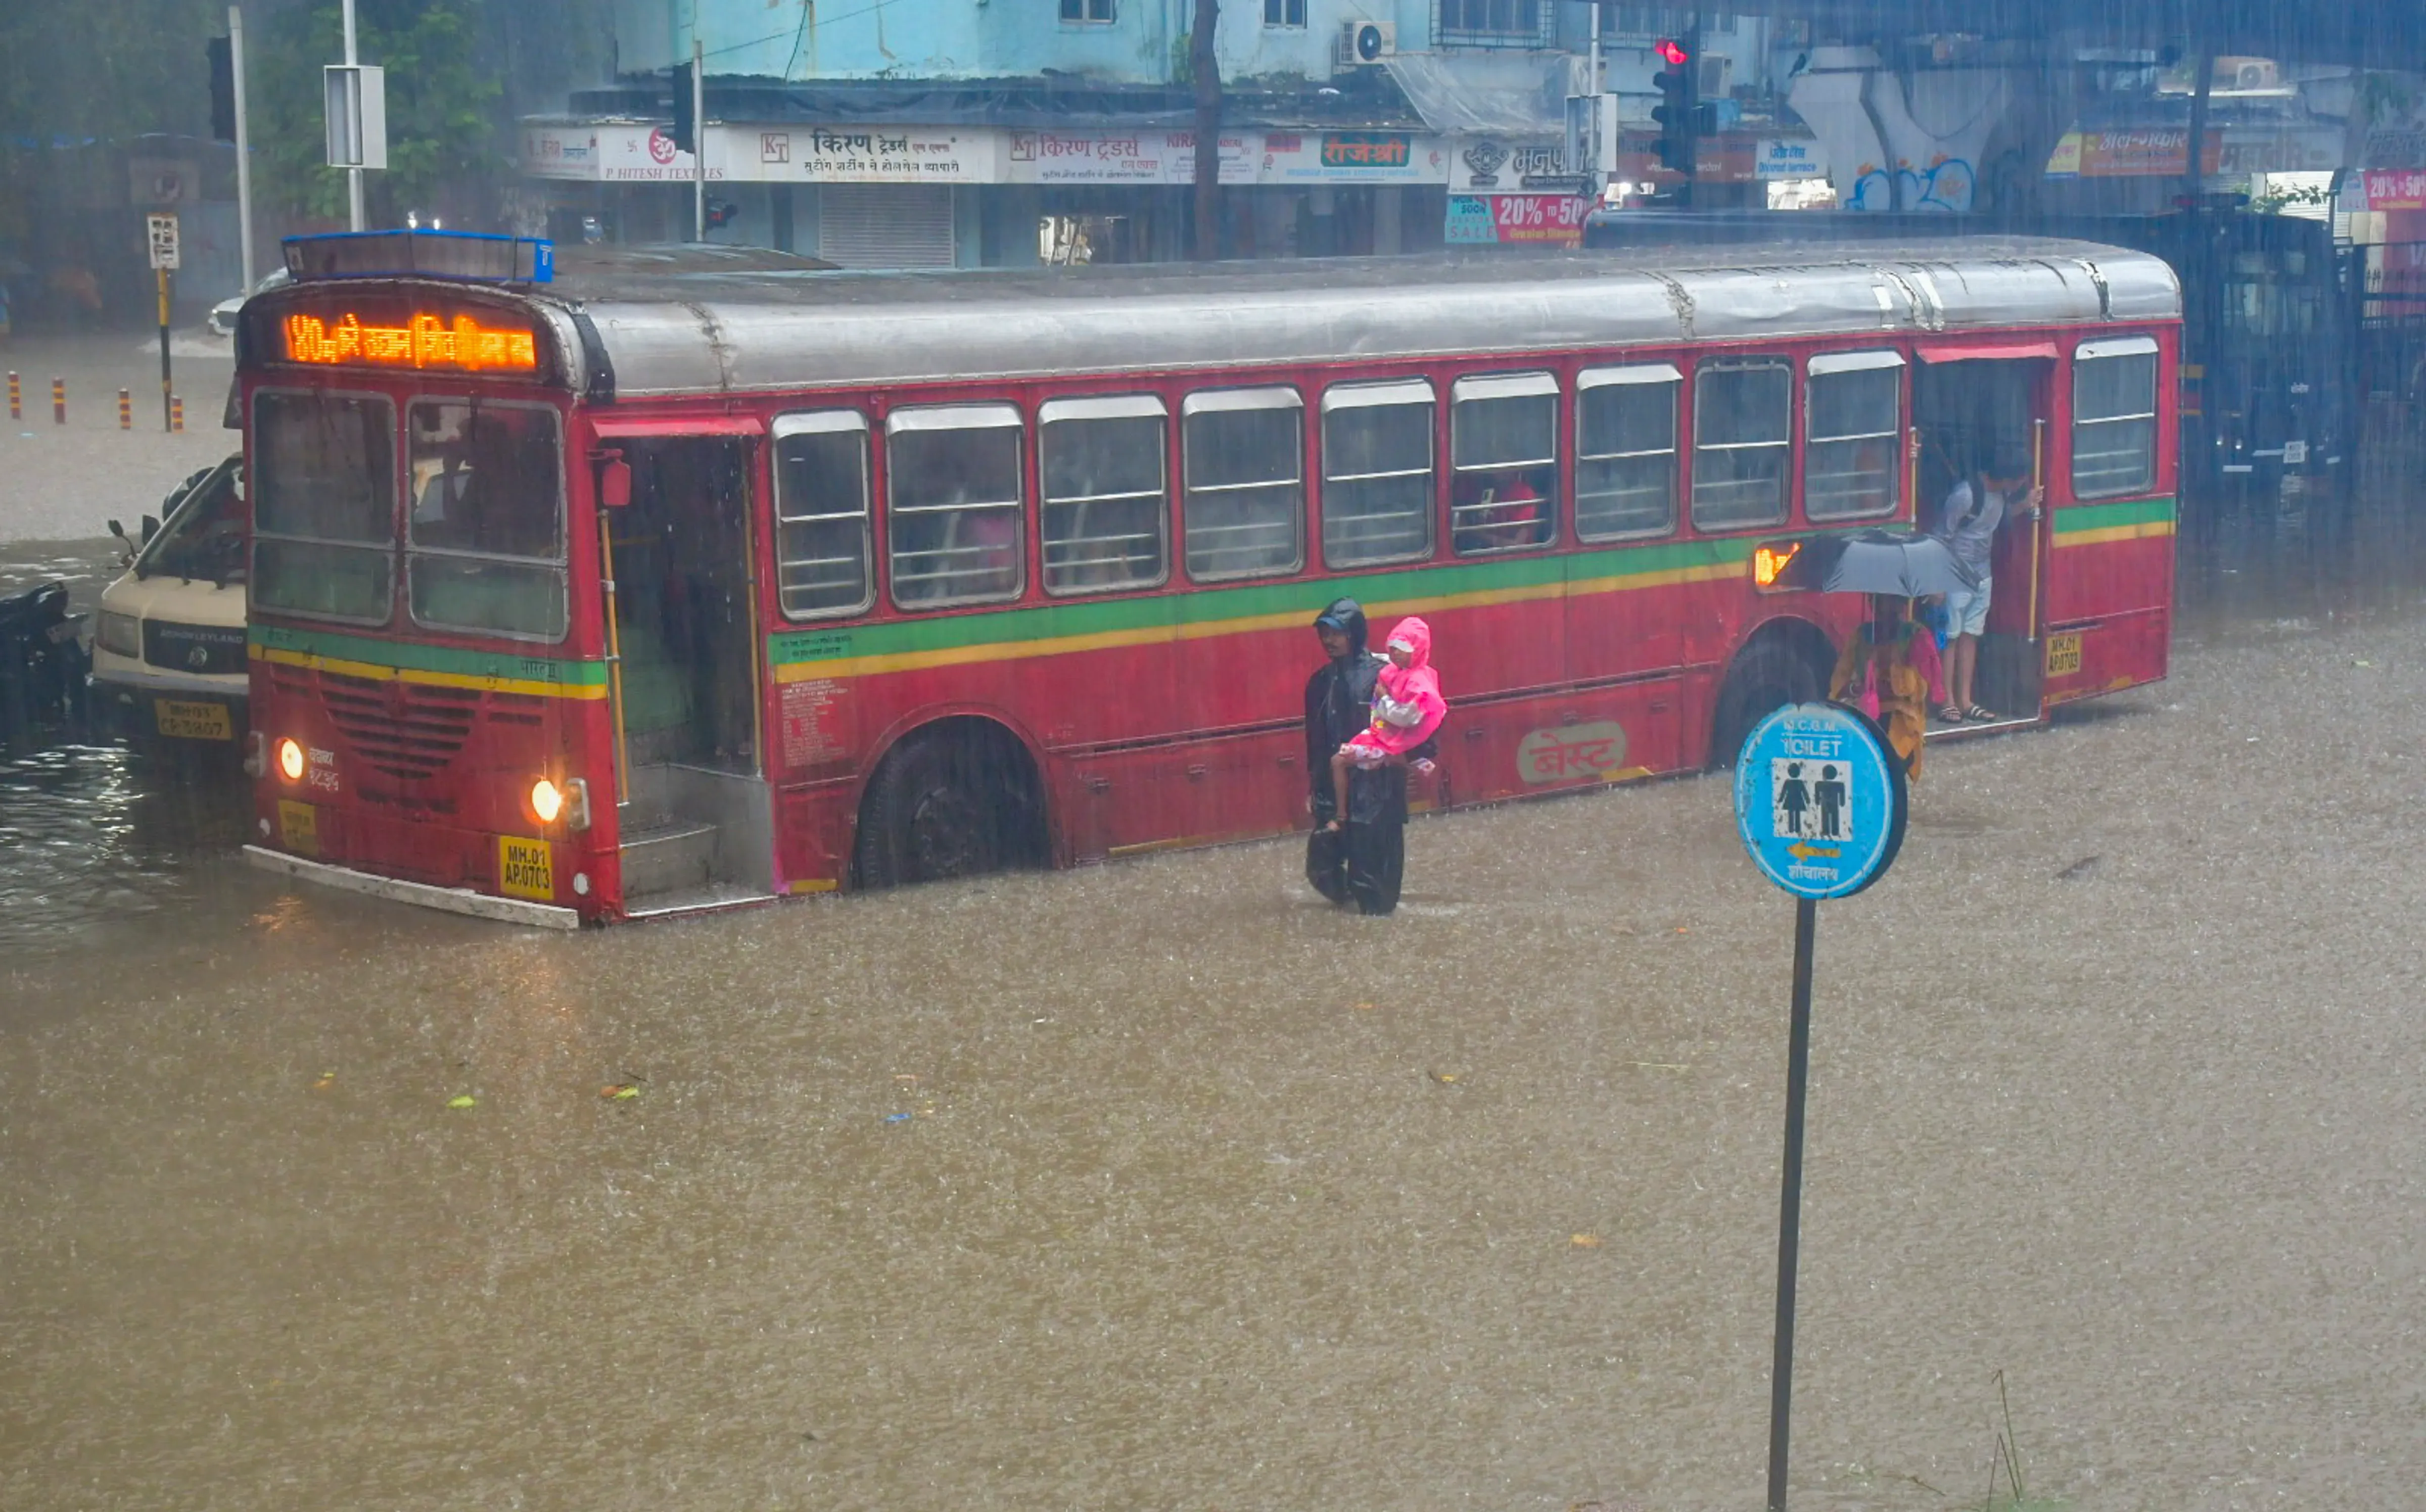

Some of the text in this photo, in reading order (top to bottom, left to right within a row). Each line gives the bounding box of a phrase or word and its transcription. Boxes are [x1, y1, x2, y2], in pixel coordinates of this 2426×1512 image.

[810, 127, 873, 156] किरण
[877, 134, 907, 155] ट्रेडर्स
[1039, 132, 1139, 161] किरण ट्रेडर्स
[618, 168, 662, 179] HITESH
[669, 168, 723, 179] TEXTLES
[2370, 176, 2397, 198] 20%
[1499, 198, 1543, 225] 20%
[1528, 732, 1615, 776] बेस्ट
[1781, 738, 1843, 757] TOILET
[507, 844, 545, 866] MH.01
[504, 862, 550, 889] AP.0703
[1786, 859, 1839, 882] शौचालय
